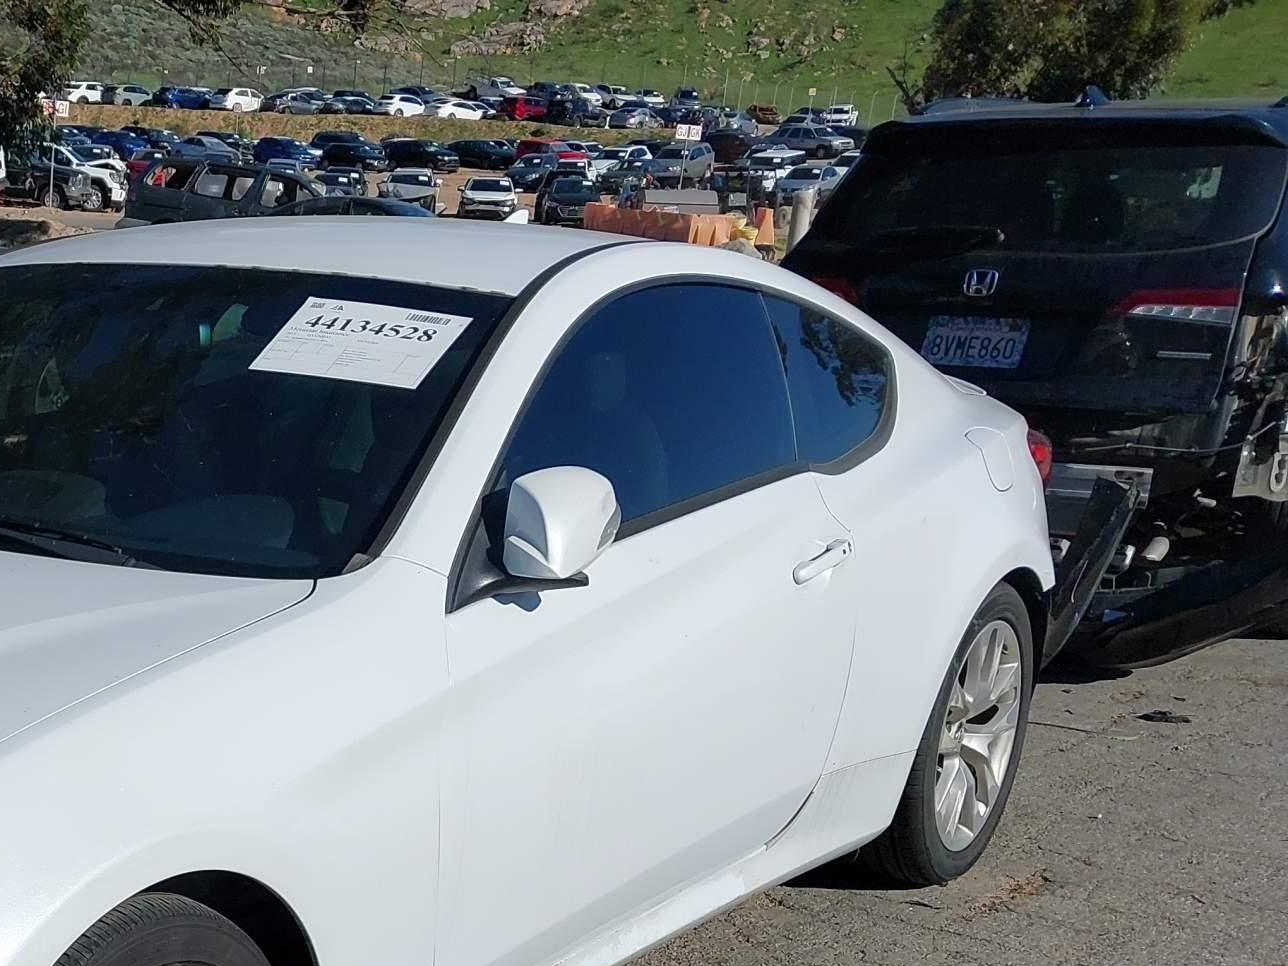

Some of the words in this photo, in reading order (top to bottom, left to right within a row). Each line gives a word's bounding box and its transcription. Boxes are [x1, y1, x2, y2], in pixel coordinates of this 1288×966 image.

[677, 126, 687, 136] GJ
[691, 126, 700, 138] GK
[305, 315, 438, 342] 44134528
[930, 335, 1017, 360] 8VME860
